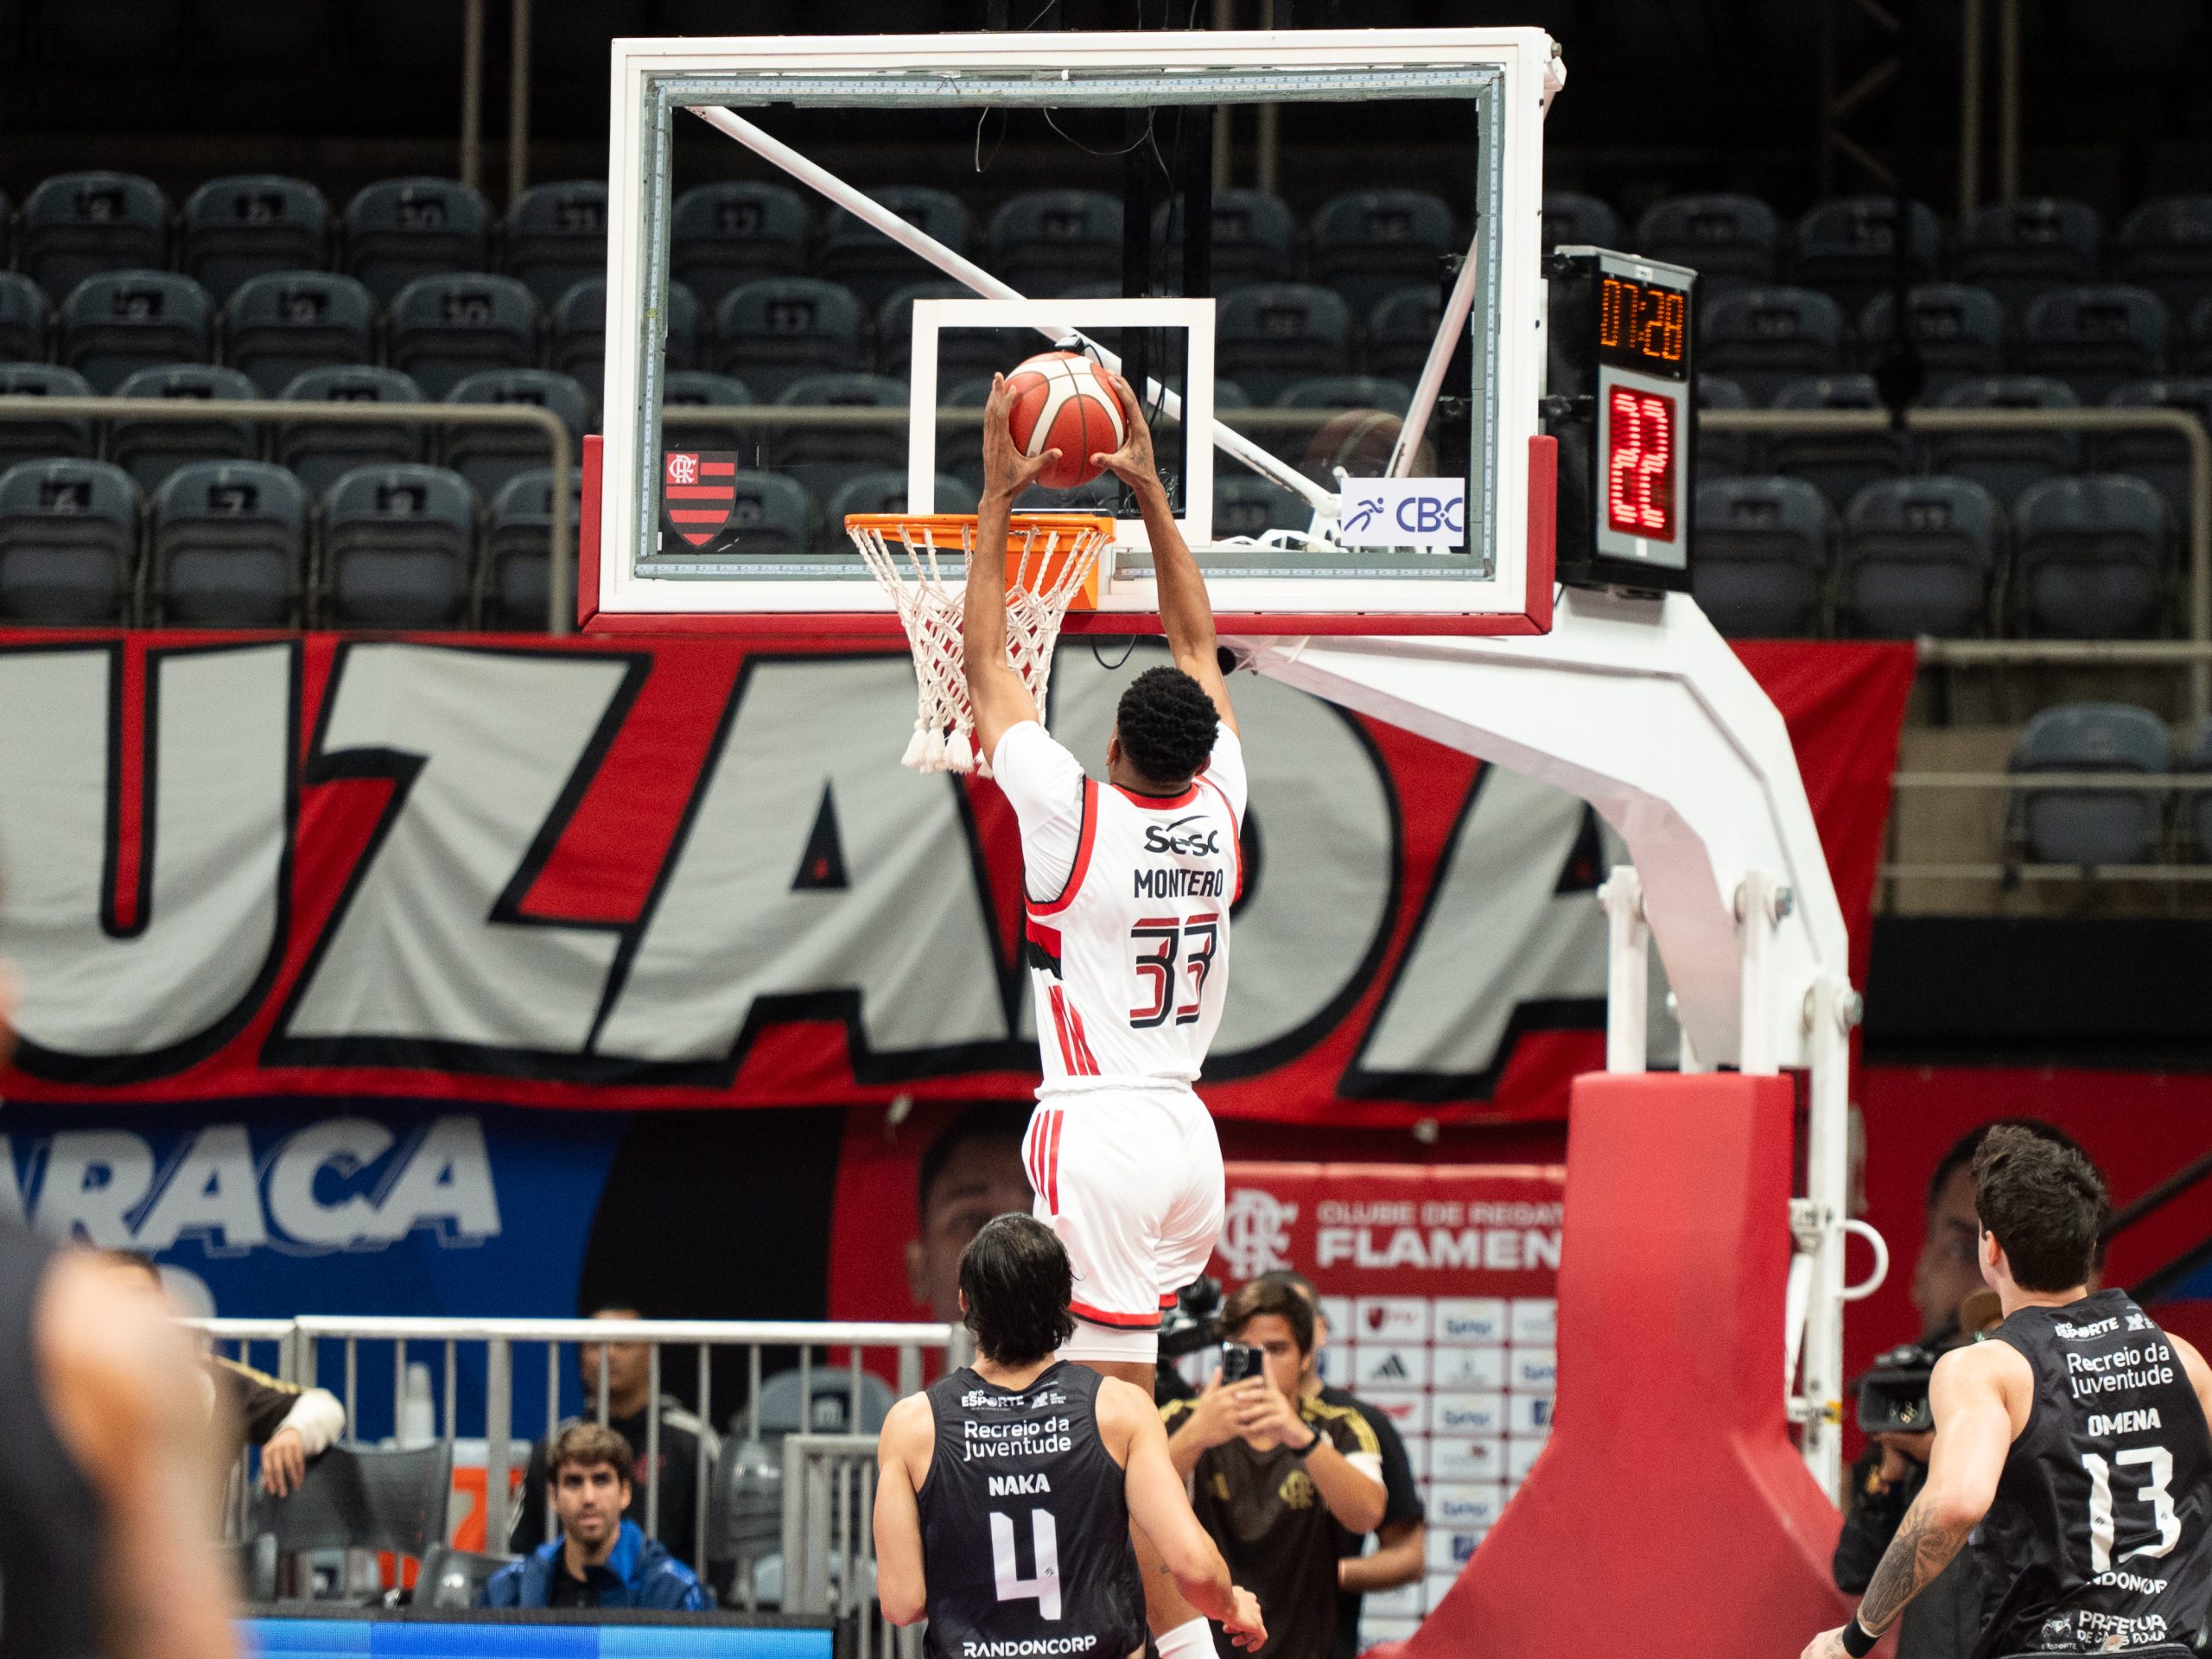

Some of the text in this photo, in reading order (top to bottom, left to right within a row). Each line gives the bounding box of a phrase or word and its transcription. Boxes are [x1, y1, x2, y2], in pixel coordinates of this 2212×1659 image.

[1601, 277, 1684, 362] 07:28
[1611, 392, 1669, 530] 22
[1396, 497, 1463, 533] CBC
[1143, 816, 1220, 857] Sesc
[1134, 868, 1224, 899] MONTERO
[1129, 912, 1220, 1029] 33
[0, 1116, 502, 1254] RACA
[1316, 1228, 1562, 1270] FLAMEN
[2066, 1342, 2171, 1374] Recreio da
[2070, 1363, 2174, 1399] Juventude
[961, 1395, 1025, 1408] ESPORTE
[964, 1415, 1070, 1439] Recreio da
[2088, 1408, 2162, 1438] OMENA
[963, 1433, 1071, 1462] Juventude
[988, 1473, 1051, 1497] NAKA
[2082, 1446, 2183, 1573] 13
[990, 1509, 1062, 1621] 4
[963, 1634, 1097, 1658] RANDONCORP
